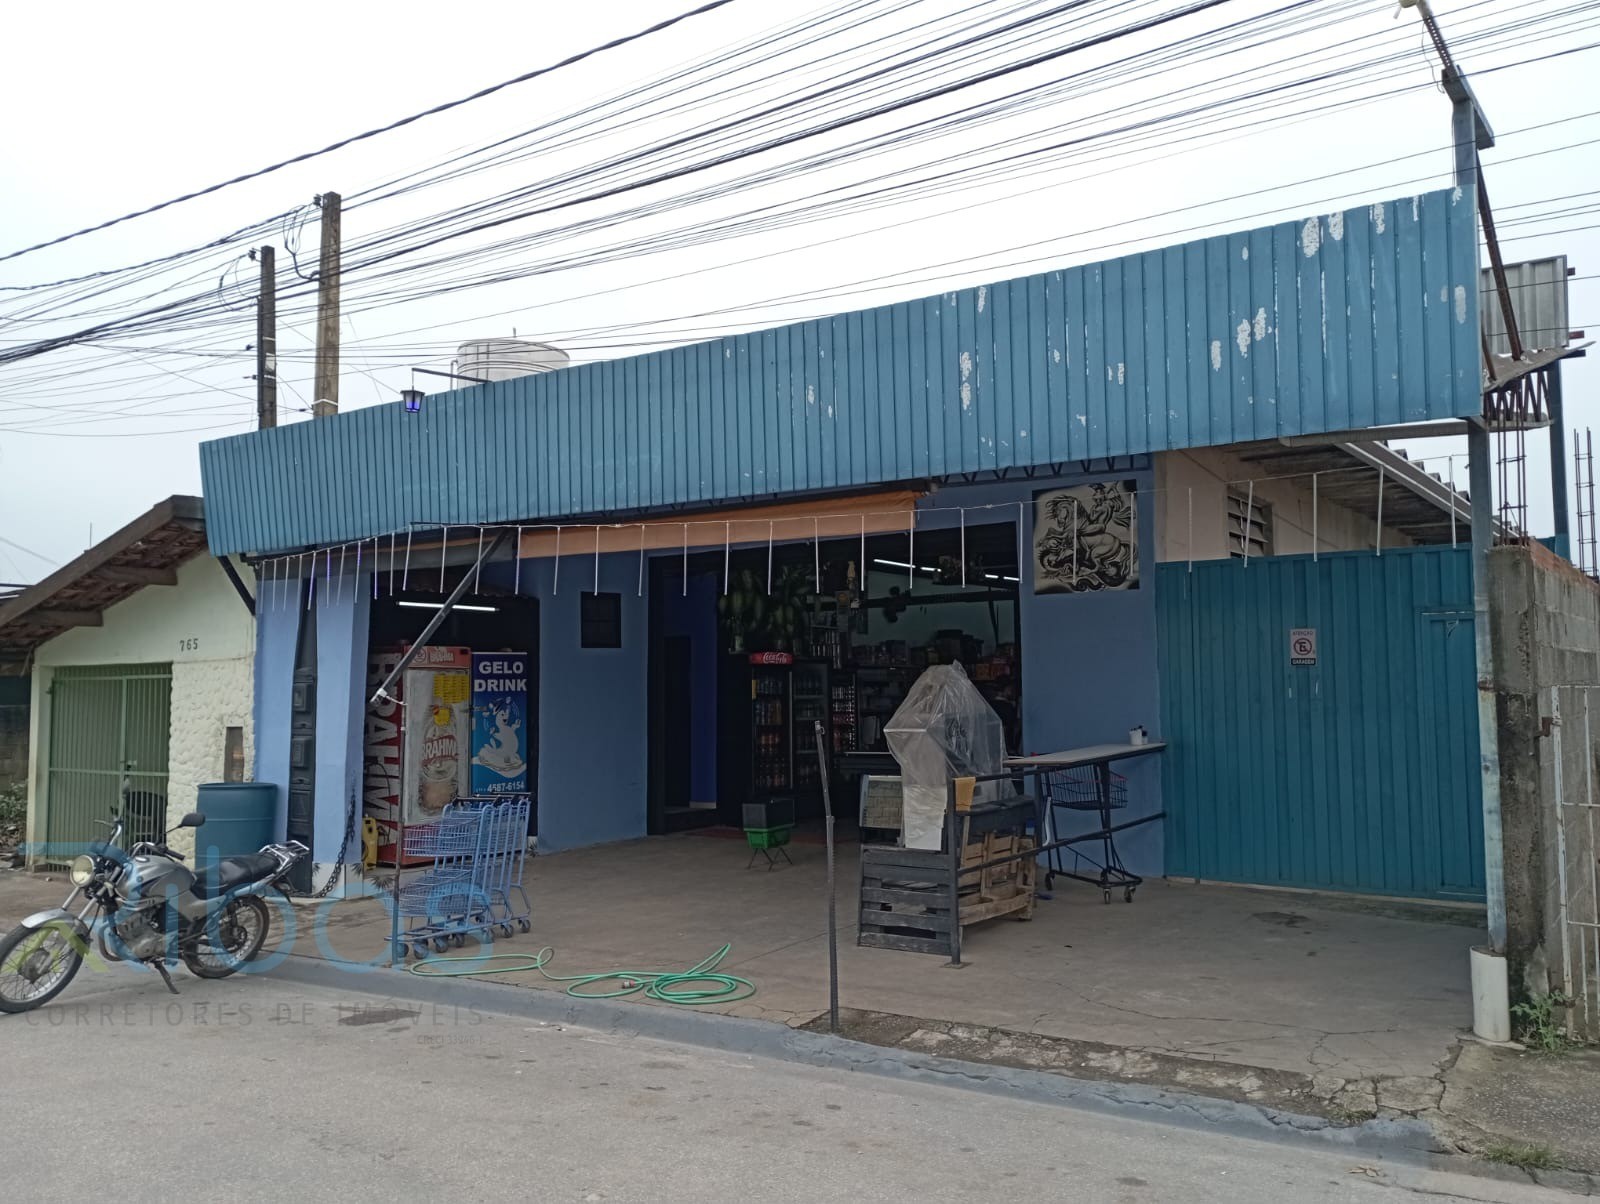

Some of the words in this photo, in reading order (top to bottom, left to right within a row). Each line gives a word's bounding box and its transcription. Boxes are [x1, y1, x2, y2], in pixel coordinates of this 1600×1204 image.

[179, 638, 199, 652] 765
[479, 661, 524, 674] GELO
[473, 678, 528, 692] DRINK
[486, 780, 525, 793] 4587-6154
